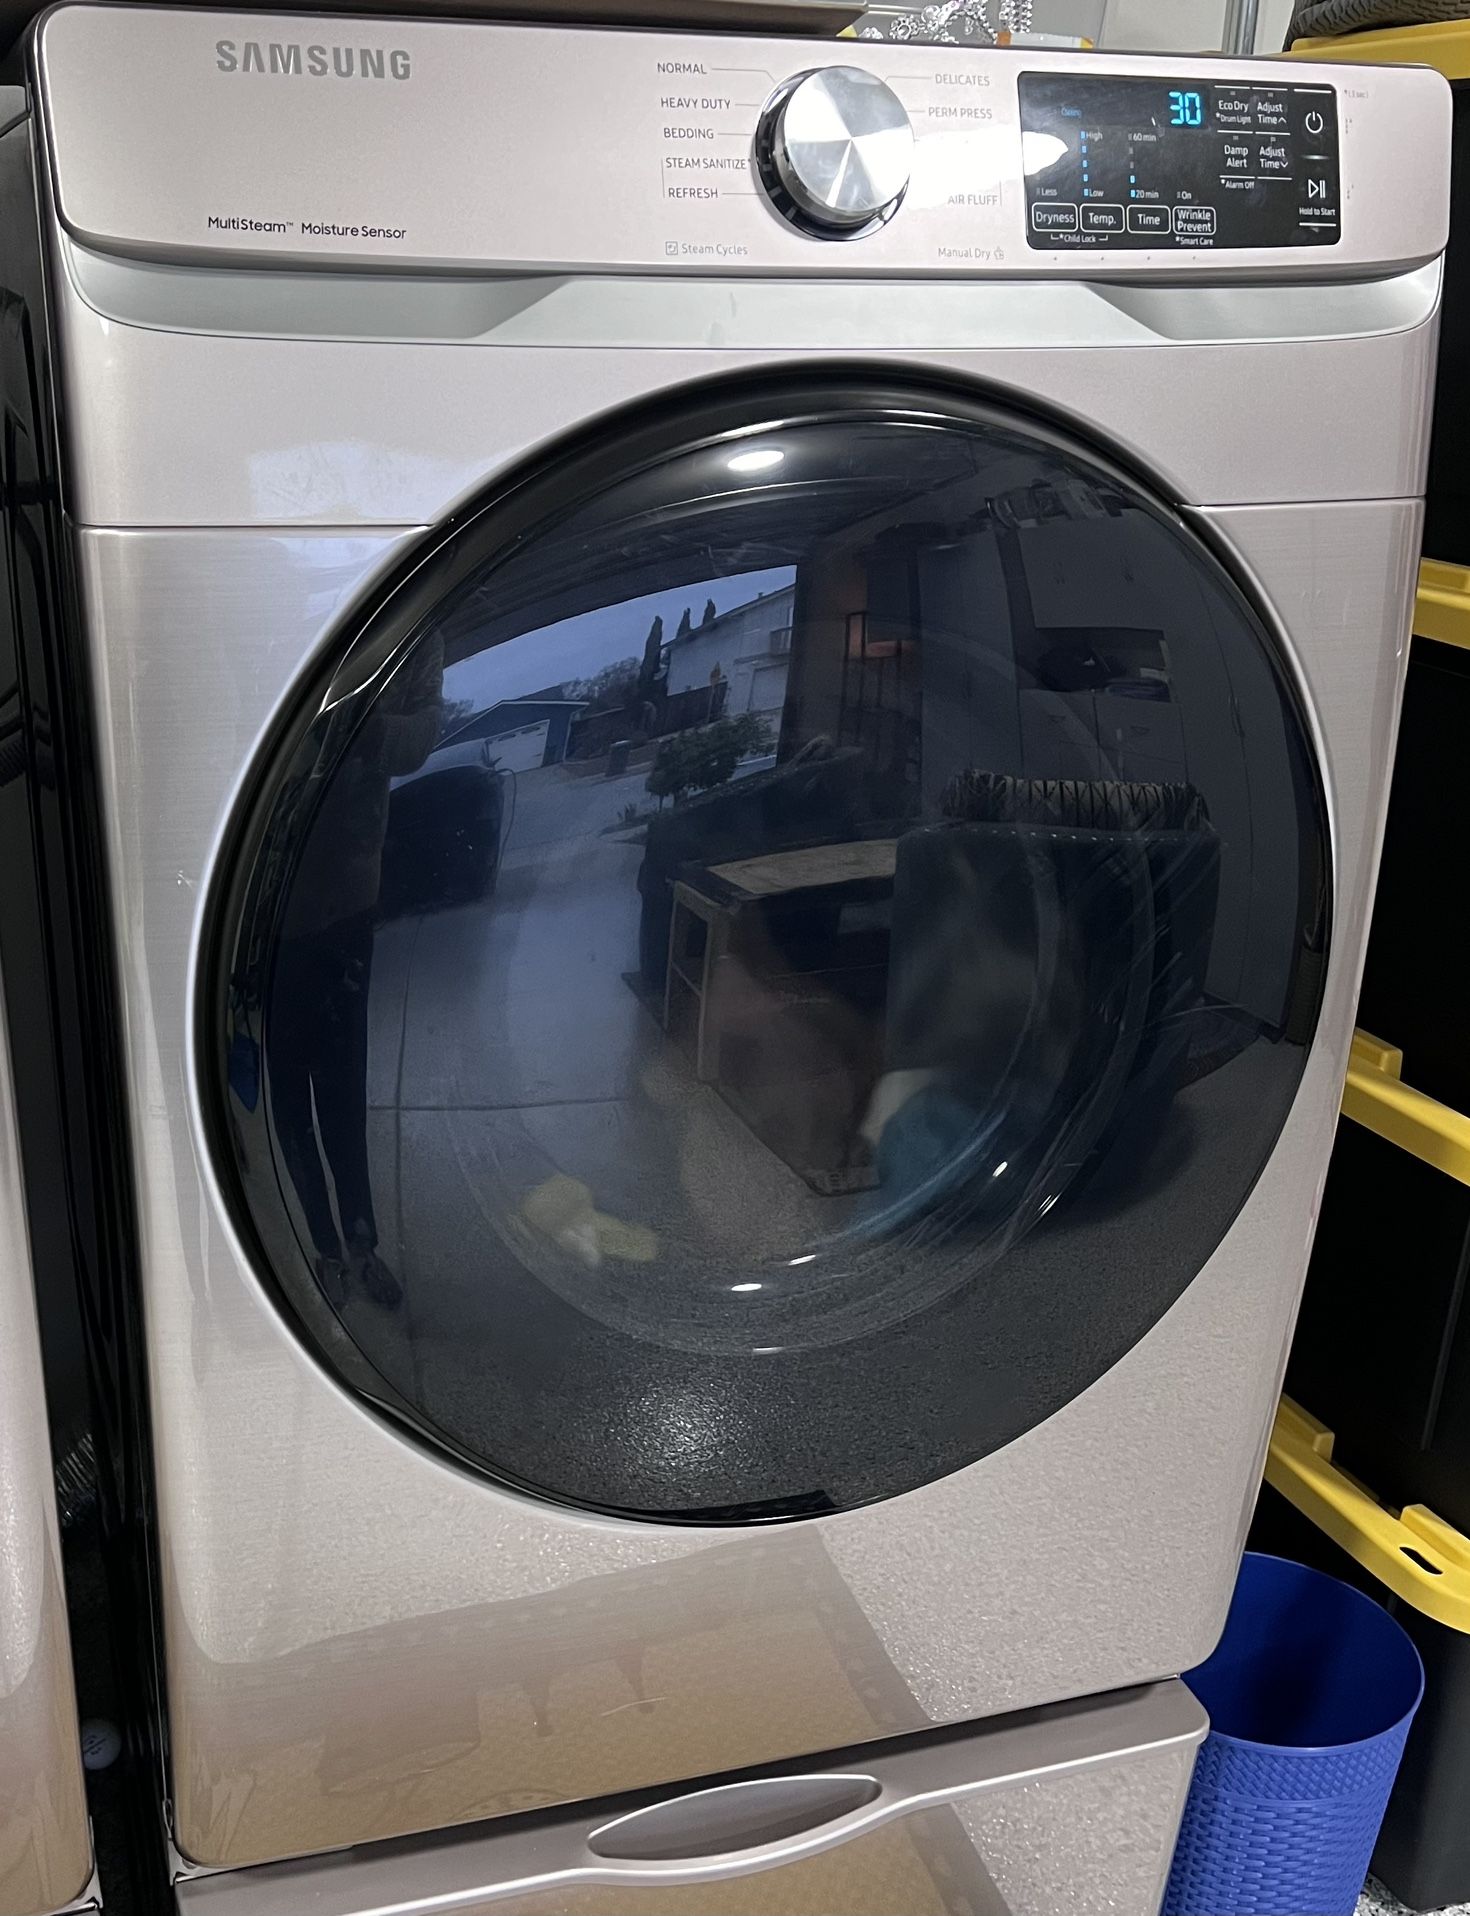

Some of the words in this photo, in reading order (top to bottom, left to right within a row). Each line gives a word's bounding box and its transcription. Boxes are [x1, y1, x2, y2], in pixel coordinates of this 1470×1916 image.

[215, 40, 411, 80] SAMSUNG
[657, 62, 707, 75] NORMAL
[935, 73, 990, 87] DELICATES
[660, 97, 698, 109] HEAVY
[702, 98, 731, 110] DUTY
[1168, 91, 1202, 125] 30
[1218, 100, 1233, 110] Eco
[1234, 101, 1249, 113] Dry
[1257, 102, 1283, 114] Adjust
[928, 106, 958, 118] PERM
[960, 107, 993, 120] PRESS
[1257, 114, 1278, 125] Time
[663, 127, 714, 139] BEDDING
[1086, 131, 1103, 142] High
[1133, 132, 1142, 142] 60
[1143, 133, 1157, 142] min
[1224, 144, 1249, 157] Damp
[1259, 146, 1286, 158] Adjust
[665, 157, 700, 169] STEAM
[702, 158, 747, 170] SANITIZE
[1226, 157, 1248, 168] Alert
[1260, 158, 1281, 169] Time
[1225, 180, 1244, 190] Alarm
[1244, 181, 1256, 190] Off
[668, 187, 718, 199] REFRESH
[1041, 188, 1058, 197] Less
[1089, 188, 1104, 198] Low
[1135, 189, 1145, 199] 20
[1145, 190, 1159, 199] min
[1181, 191, 1192, 200] On
[947, 194, 965, 205] AIR
[967, 194, 998, 206] FLUFF
[1035, 211, 1075, 224] Dryness
[1177, 209, 1211, 221] Wrinkle
[1299, 207, 1313, 216] Hold
[1320, 207, 1336, 216] Start
[1088, 213, 1117, 227] Temp.
[1137, 213, 1161, 226] Time
[301, 222, 359, 237] Moisture
[361, 225, 407, 239] Sensor
[1177, 221, 1212, 233] Prevent
[1064, 234, 1082, 242] Child
[1081, 234, 1096, 243] Lock
[1180, 236, 1199, 245] Smart
[1199, 237, 1213, 245] Care
[681, 243, 714, 255] Steam
[716, 243, 748, 256] Cycles
[938, 247, 972, 258] Manual
[974, 248, 991, 260] Dry
